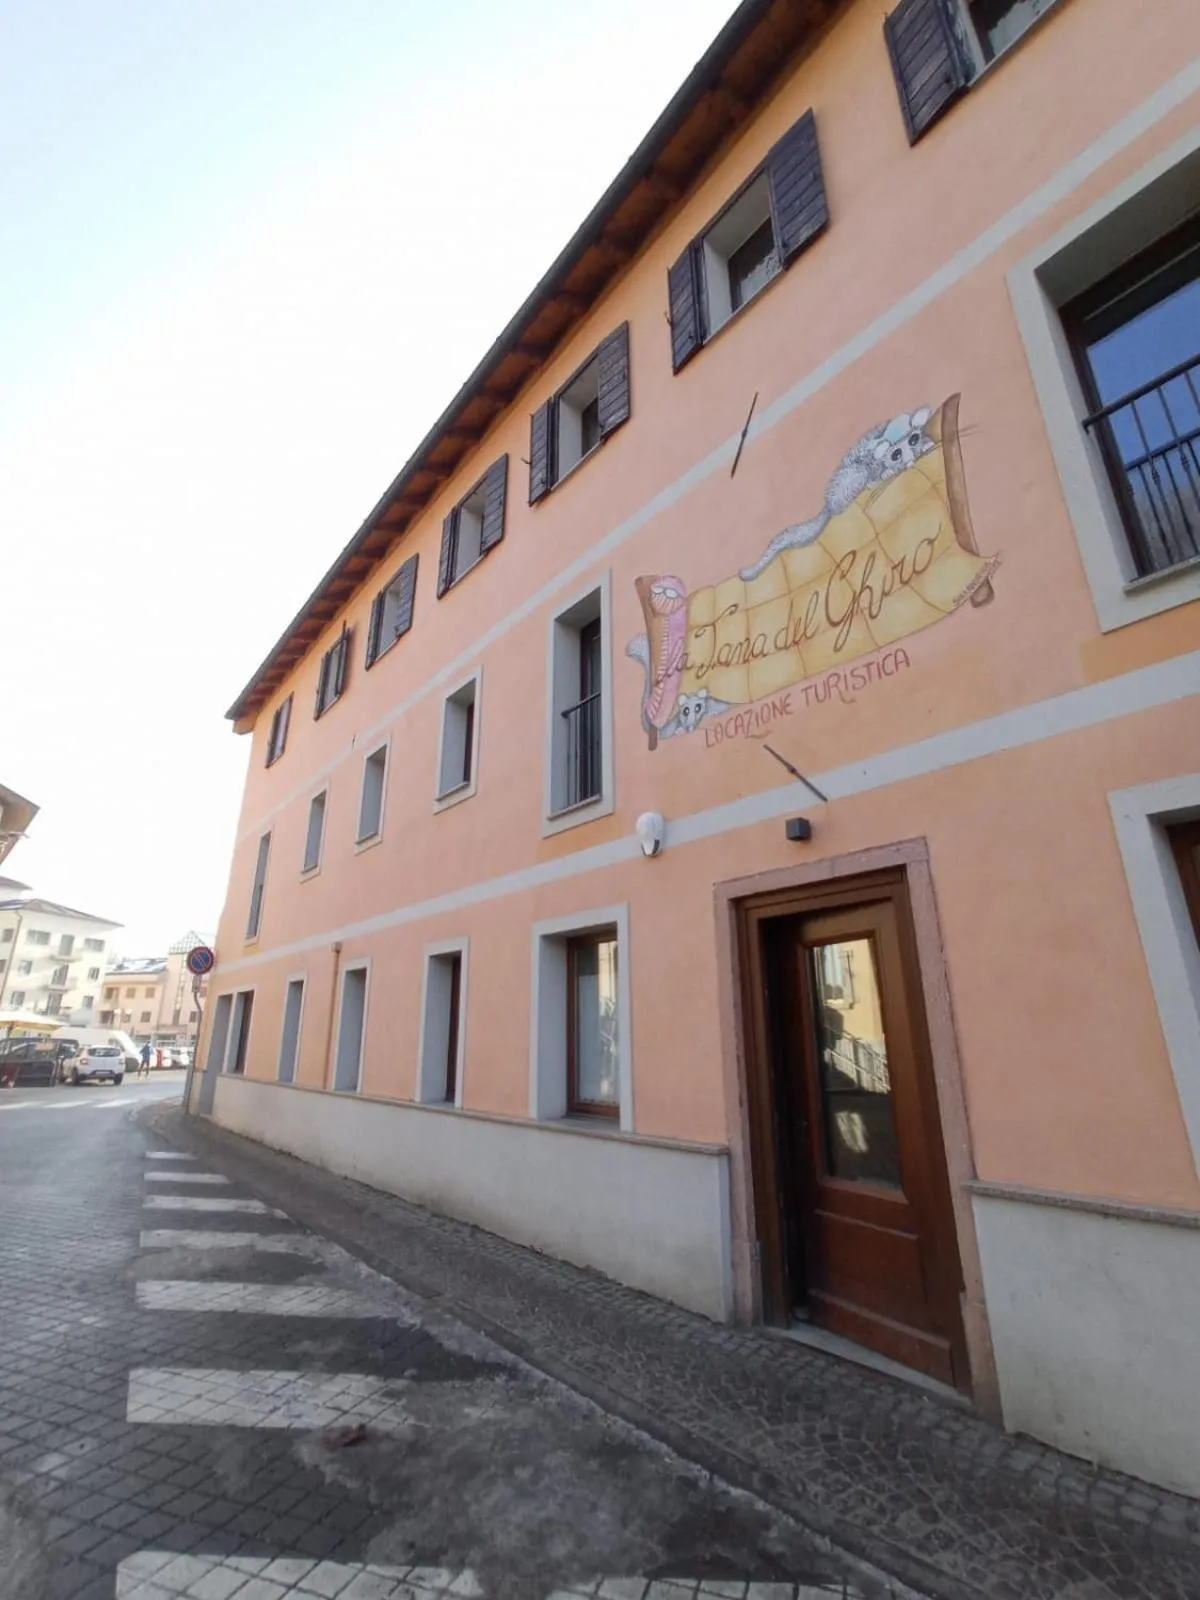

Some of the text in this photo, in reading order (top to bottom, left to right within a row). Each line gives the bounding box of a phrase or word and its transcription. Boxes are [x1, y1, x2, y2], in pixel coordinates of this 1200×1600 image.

[694, 603, 768, 680] Tana
[773, 589, 820, 651] del
[704, 646, 911, 748] LOCAZIONE TURISTICA
